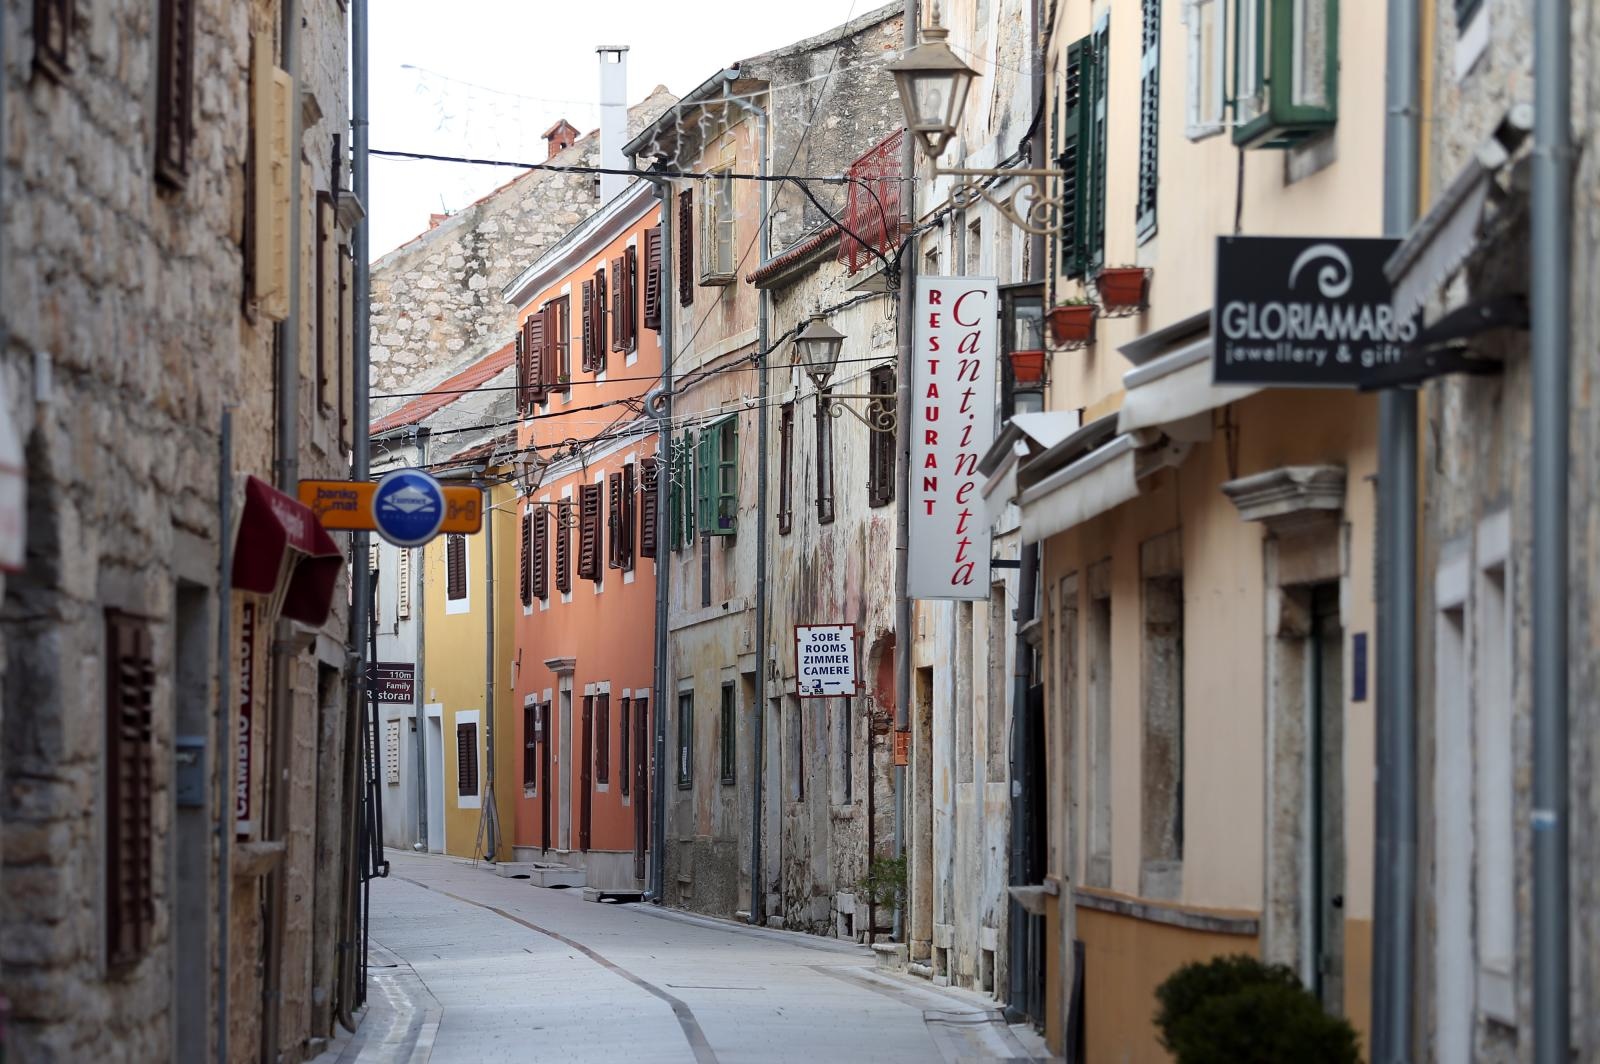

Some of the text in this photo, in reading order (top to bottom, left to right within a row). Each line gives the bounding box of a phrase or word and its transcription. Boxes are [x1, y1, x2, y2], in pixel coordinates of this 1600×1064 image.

[1225, 342, 1327, 367] jewellery
[1335, 343, 1352, 363] &
[923, 289, 942, 516] RESTAURANT
[950, 289, 988, 586] Cantinetta
[811, 633, 841, 642] SOBE
[805, 643, 847, 653] ROOMS
[803, 655, 849, 664] ZIMMER
[389, 671, 412, 679] 110m
[803, 666, 850, 675] CAMERE
[386, 681, 411, 692] Family
[366, 690, 411, 701] Rstoran
